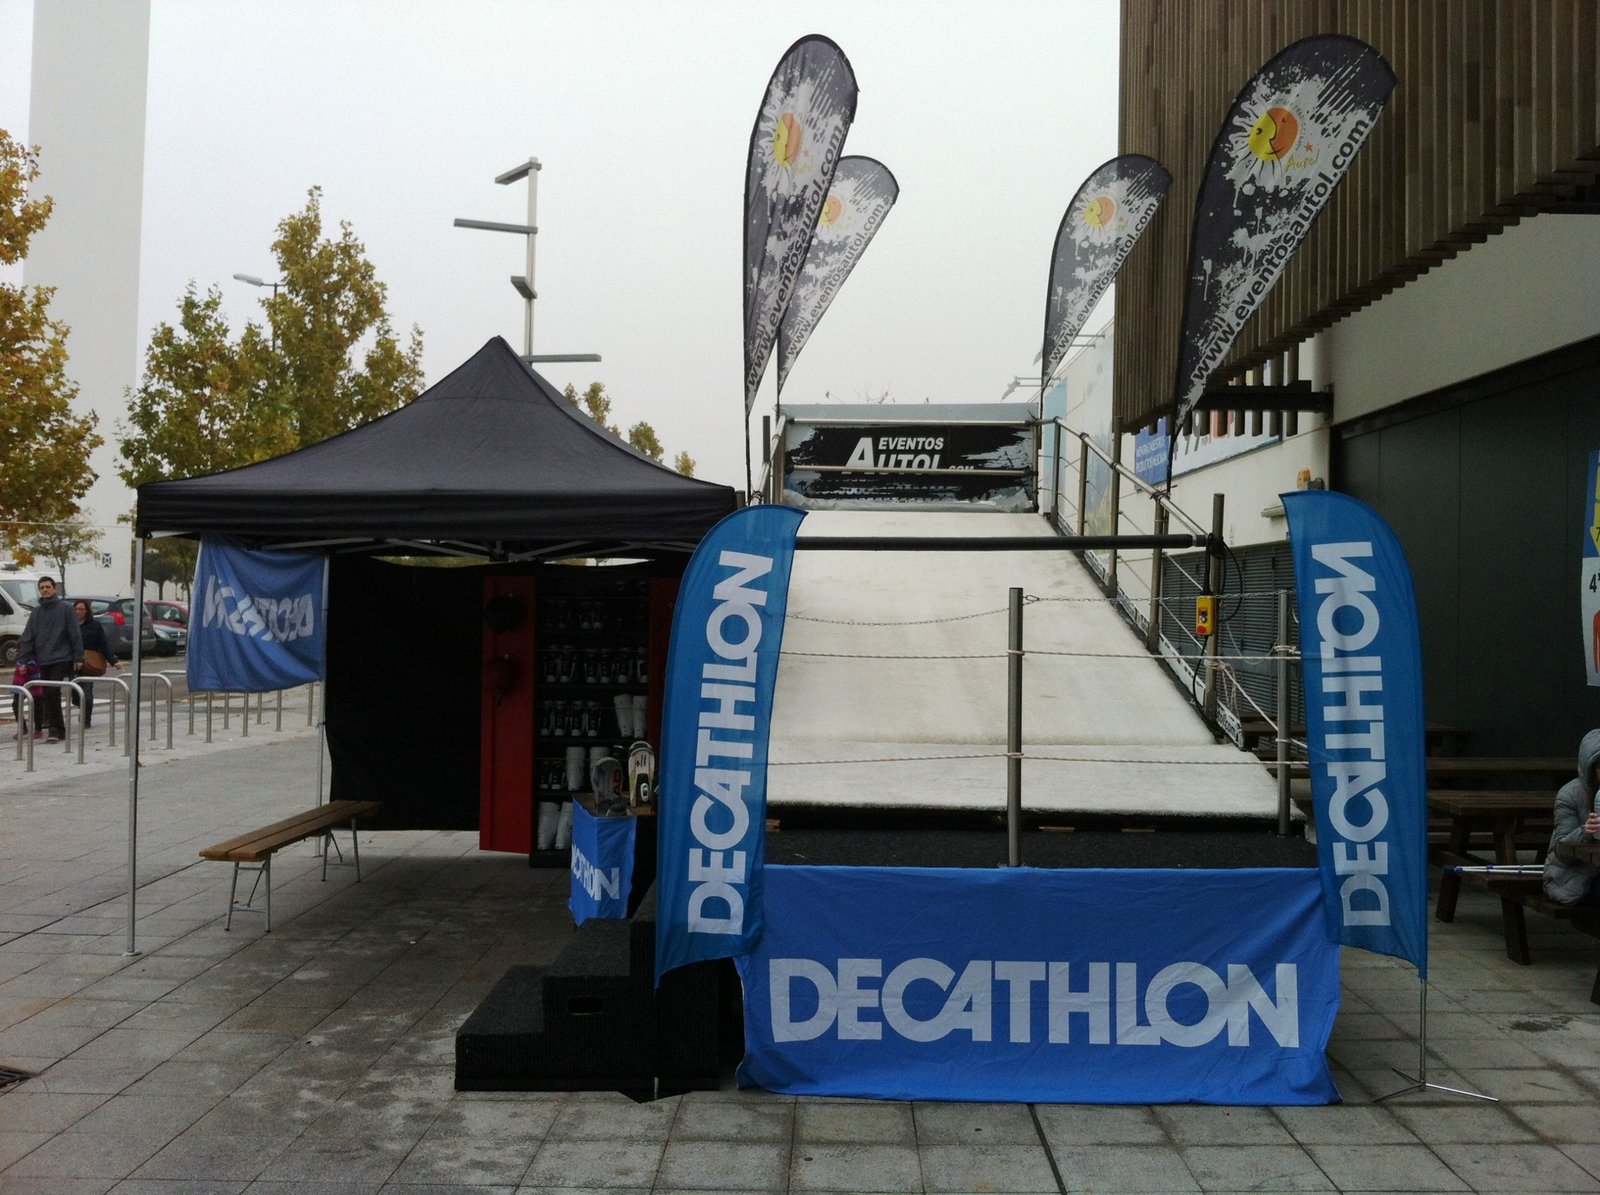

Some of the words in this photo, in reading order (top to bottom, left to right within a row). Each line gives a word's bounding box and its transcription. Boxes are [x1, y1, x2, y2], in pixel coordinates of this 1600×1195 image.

[748, 125, 842, 386] www.eventosautol.com
[788, 204, 885, 356] www.eventosautol.com
[1051, 201, 1156, 361] www.eventosautol.com
[1193, 118, 1368, 381] www.eventosautol.com
[878, 437, 944, 450] EVENTOS
[688, 550, 774, 935] DECATHLON
[769, 958, 1300, 1048] DECATHLON
